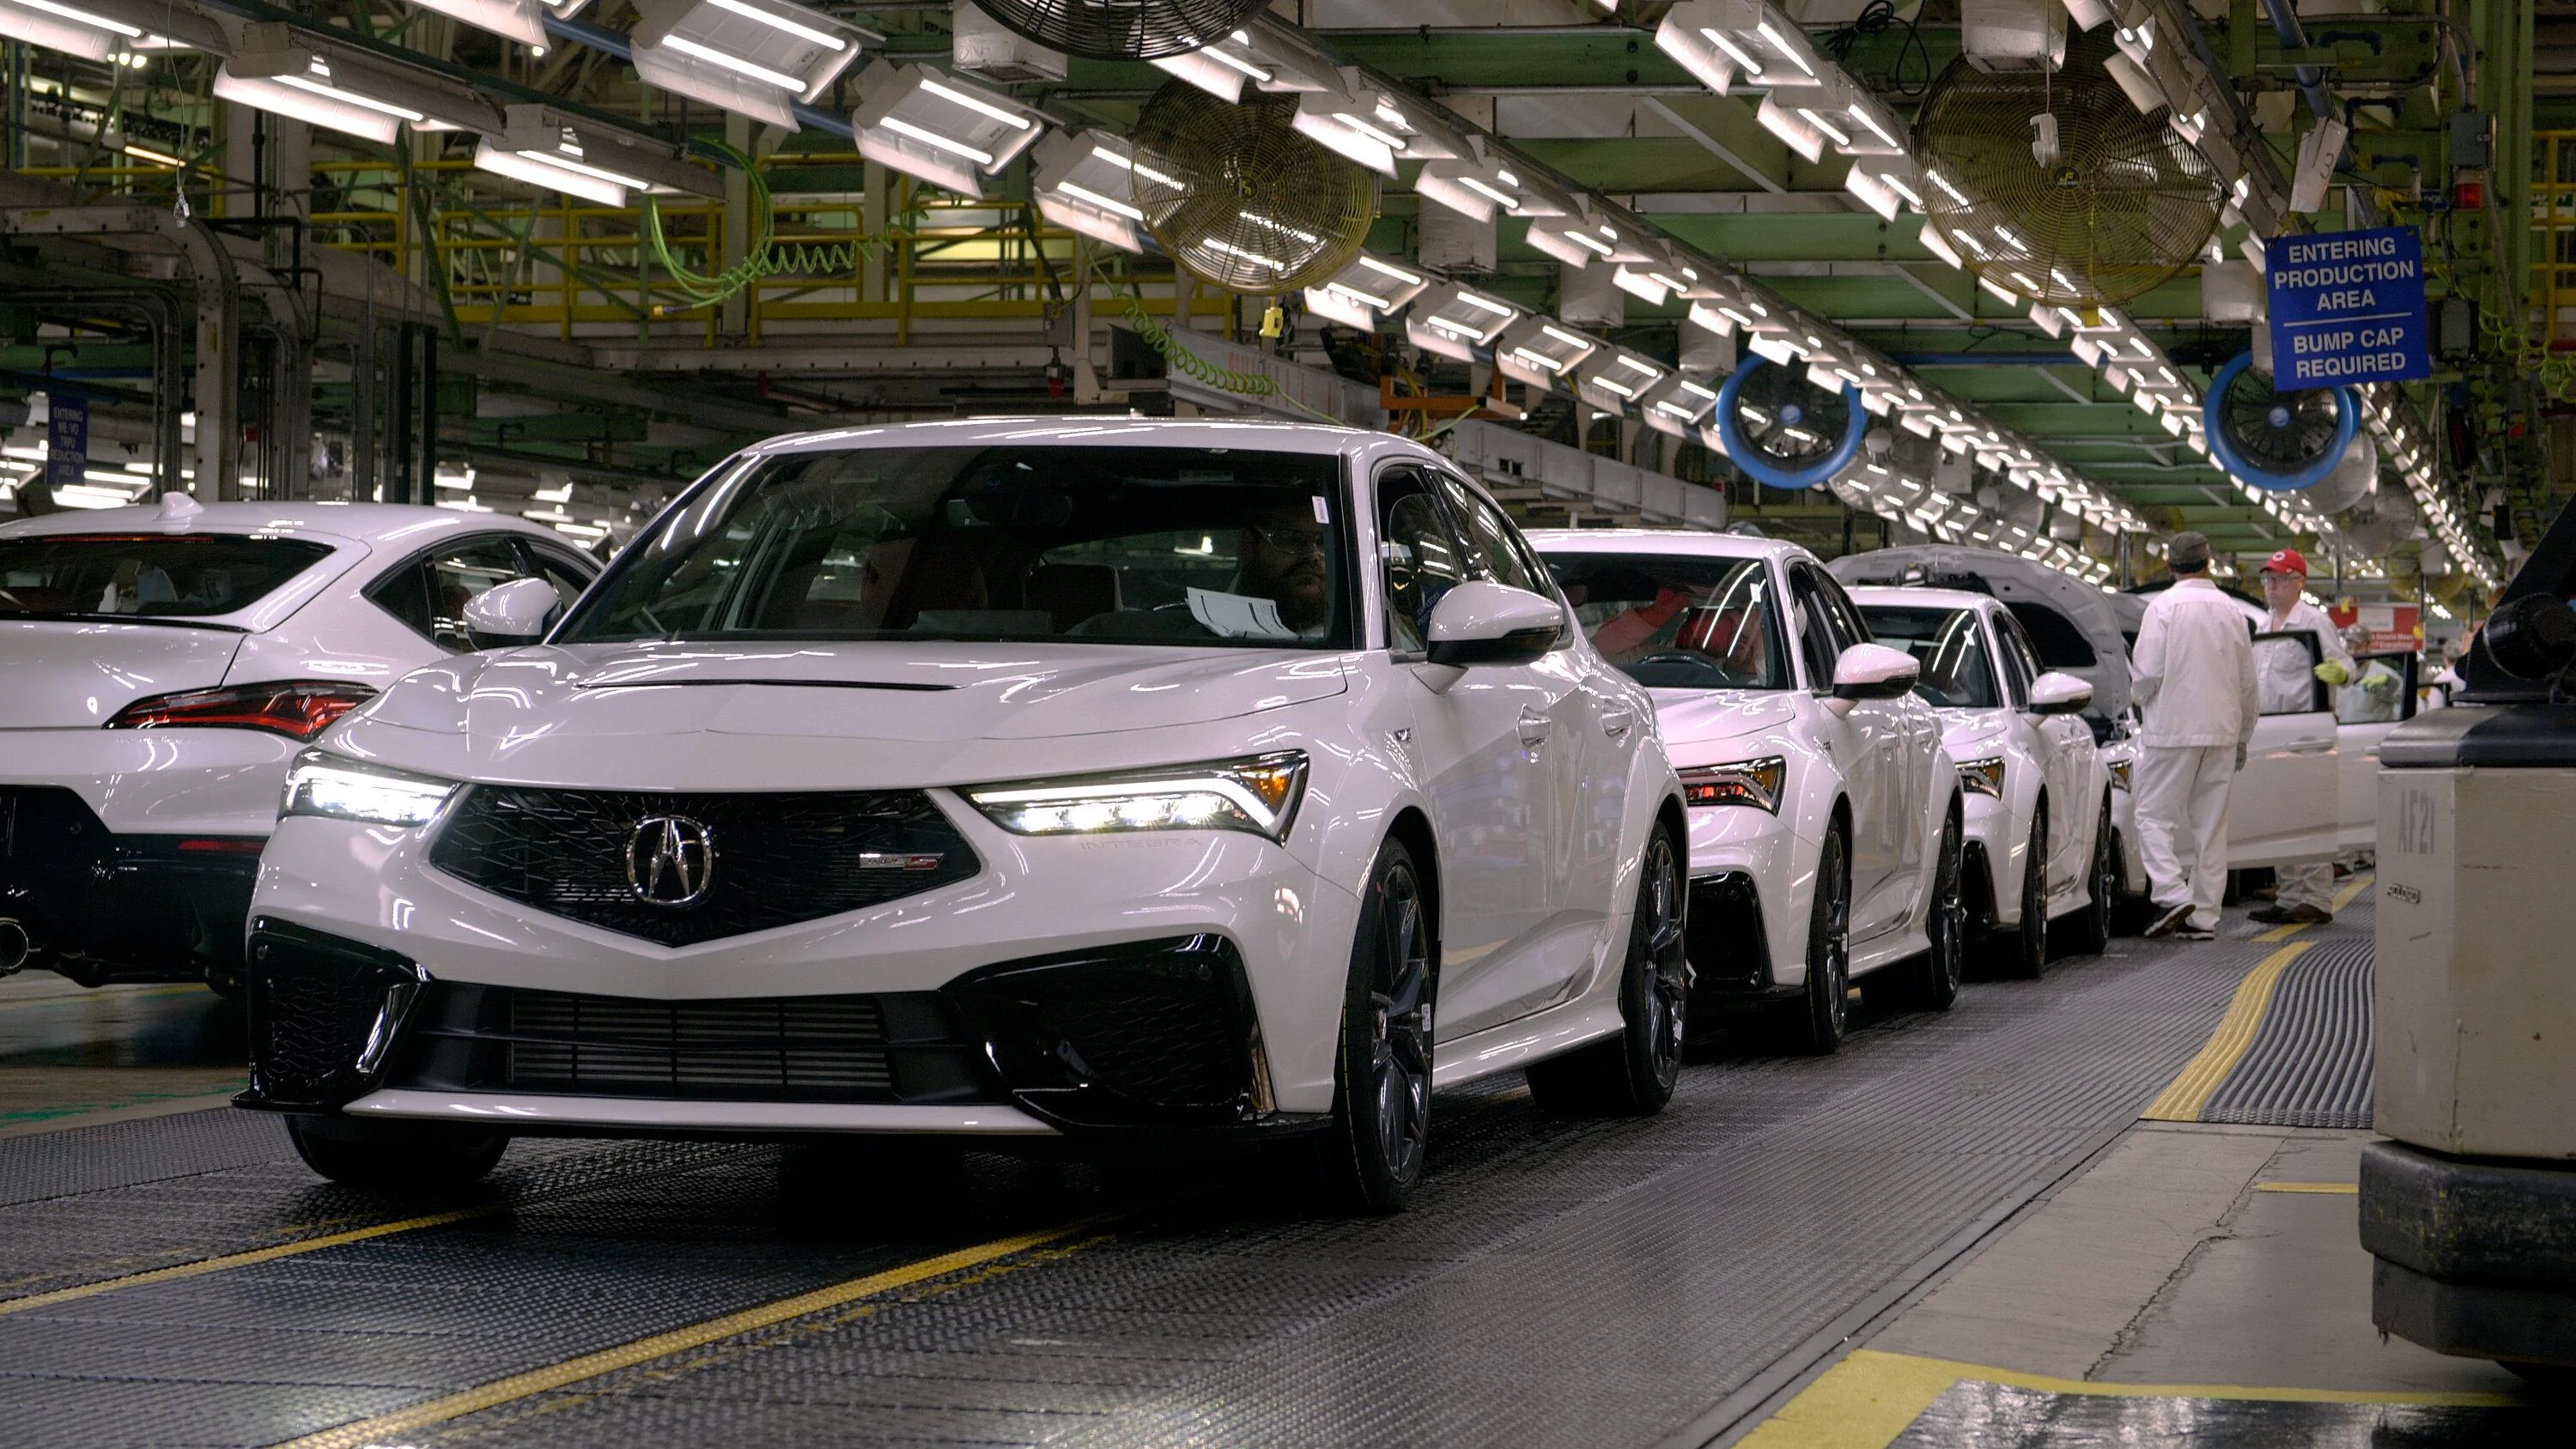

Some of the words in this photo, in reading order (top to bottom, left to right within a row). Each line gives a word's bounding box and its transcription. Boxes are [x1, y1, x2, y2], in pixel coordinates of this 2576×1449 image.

[2320, 153, 2335, 179] 3
[2288, 237, 2396, 264] ENTERING
[2275, 260, 2415, 289] PRODUCTION
[2317, 289, 2377, 311] AREA
[2293, 331, 2354, 354] BUMP
[2360, 327, 2404, 348] CAP
[2296, 352, 2406, 379] REQUIRED
[53, 408, 83, 422] ENTERING
[1079, 838, 1202, 851] INTEGRA
